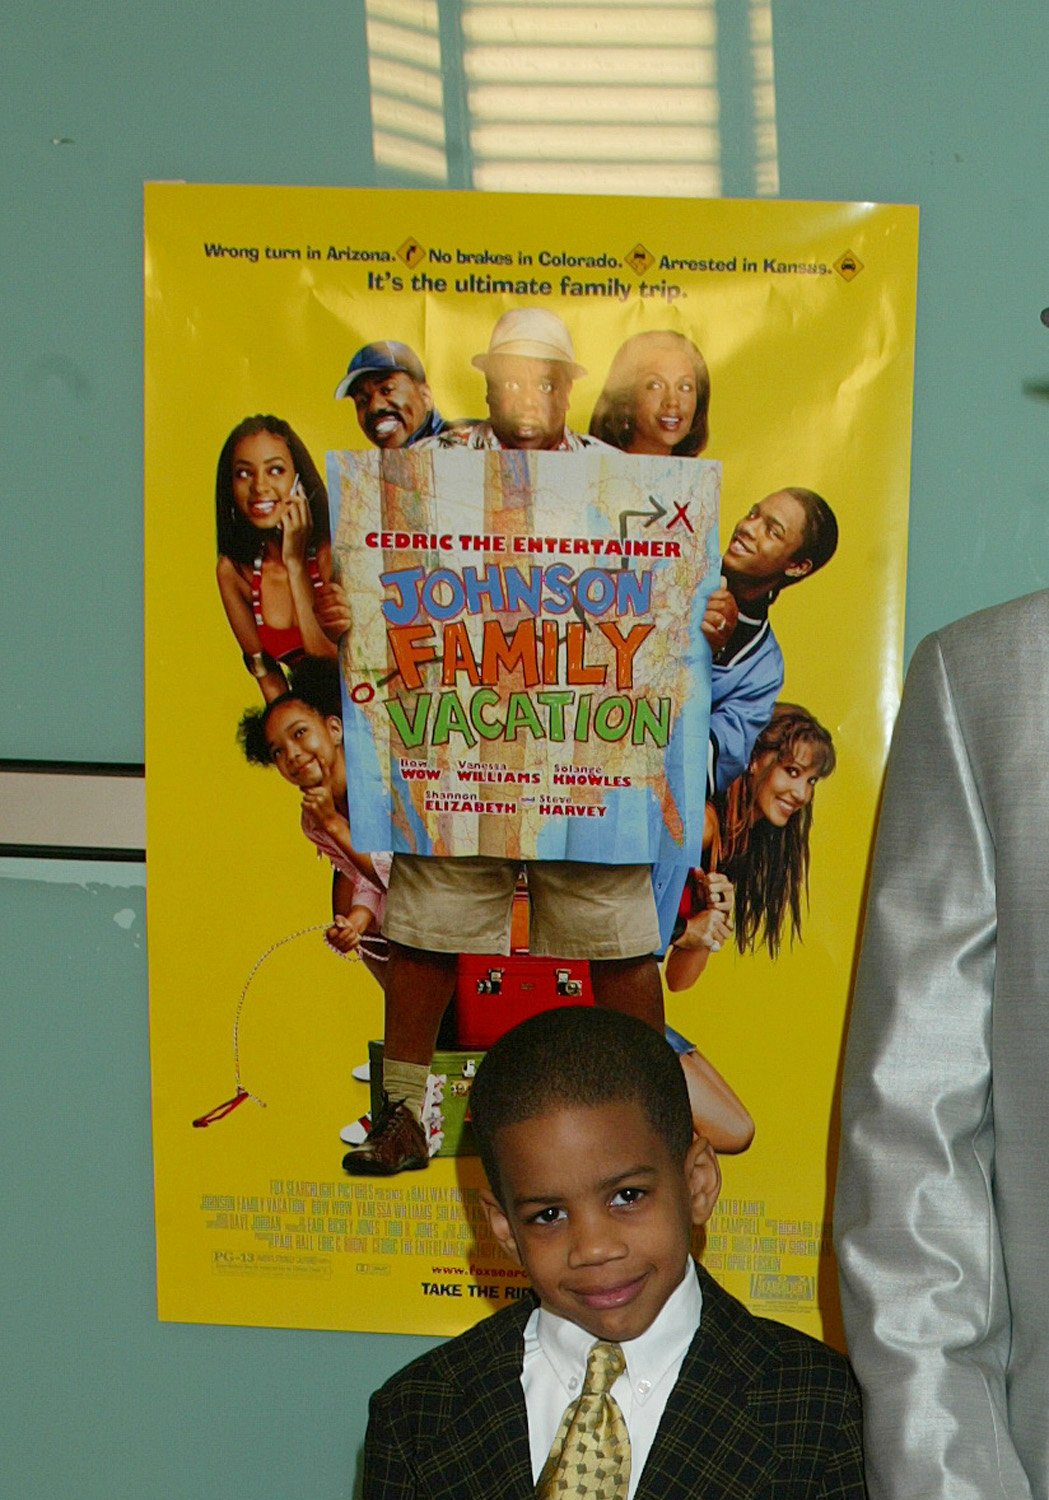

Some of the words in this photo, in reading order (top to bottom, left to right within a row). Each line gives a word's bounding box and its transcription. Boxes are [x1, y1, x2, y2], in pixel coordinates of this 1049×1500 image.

[204, 243, 259, 261] Wrong
[265, 248, 301, 259] turn
[307, 247, 321, 260] in
[326, 246, 396, 262] Arizona.
[429, 248, 452, 264] No
[456, 248, 512, 266] brakes
[518, 250, 534, 266] in
[538, 251, 623, 269] Colorado.
[659, 255, 737, 273] Arrested
[742, 255, 757, 273] in
[763, 257, 832, 275] Kansas.
[368, 271, 404, 292] It's
[411, 273, 447, 292] the
[455, 275, 552, 295] ultimate
[560, 276, 631, 300] family
[639, 280, 688, 303] trip.
[365, 531, 453, 551] CEDRIC
[459, 535, 505, 552] THE
[513, 537, 682, 558] ENTERTAINER
[379, 563, 653, 626] JOHNSON
[386, 618, 656, 692] FAMILY
[382, 688, 671, 749] VACATION
[401, 769, 442, 780] WOW
[554, 763, 602, 775] Solange
[457, 770, 541, 784] WILLIAMS
[553, 774, 631, 788] KNOWLES
[425, 790, 477, 801] Shannon
[425, 800, 516, 814] ELIZABETH
[539, 804, 607, 817] HARVEY
[421, 1282, 462, 1296] TAKE
[467, 1284, 500, 1298] THE
